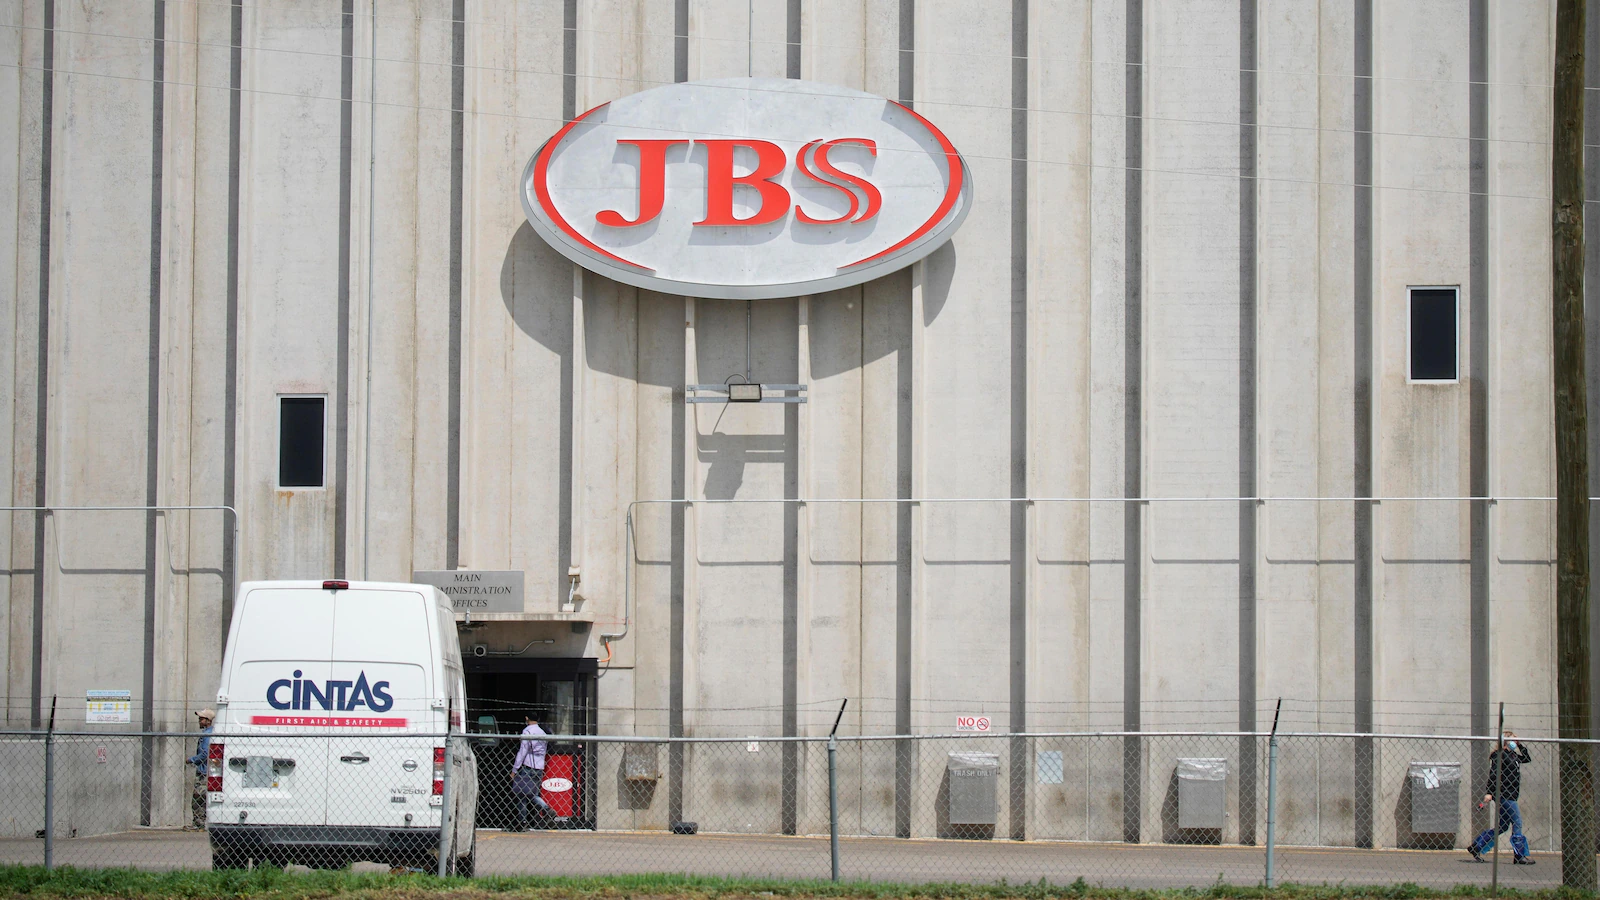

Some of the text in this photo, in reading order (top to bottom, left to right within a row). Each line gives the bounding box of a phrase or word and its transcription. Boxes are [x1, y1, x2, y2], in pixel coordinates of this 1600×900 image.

[595, 137, 882, 228] JBS
[453, 574, 482, 582] MAIN
[436, 586, 512, 595] MINISTRATION
[957, 717, 975, 727] NO
